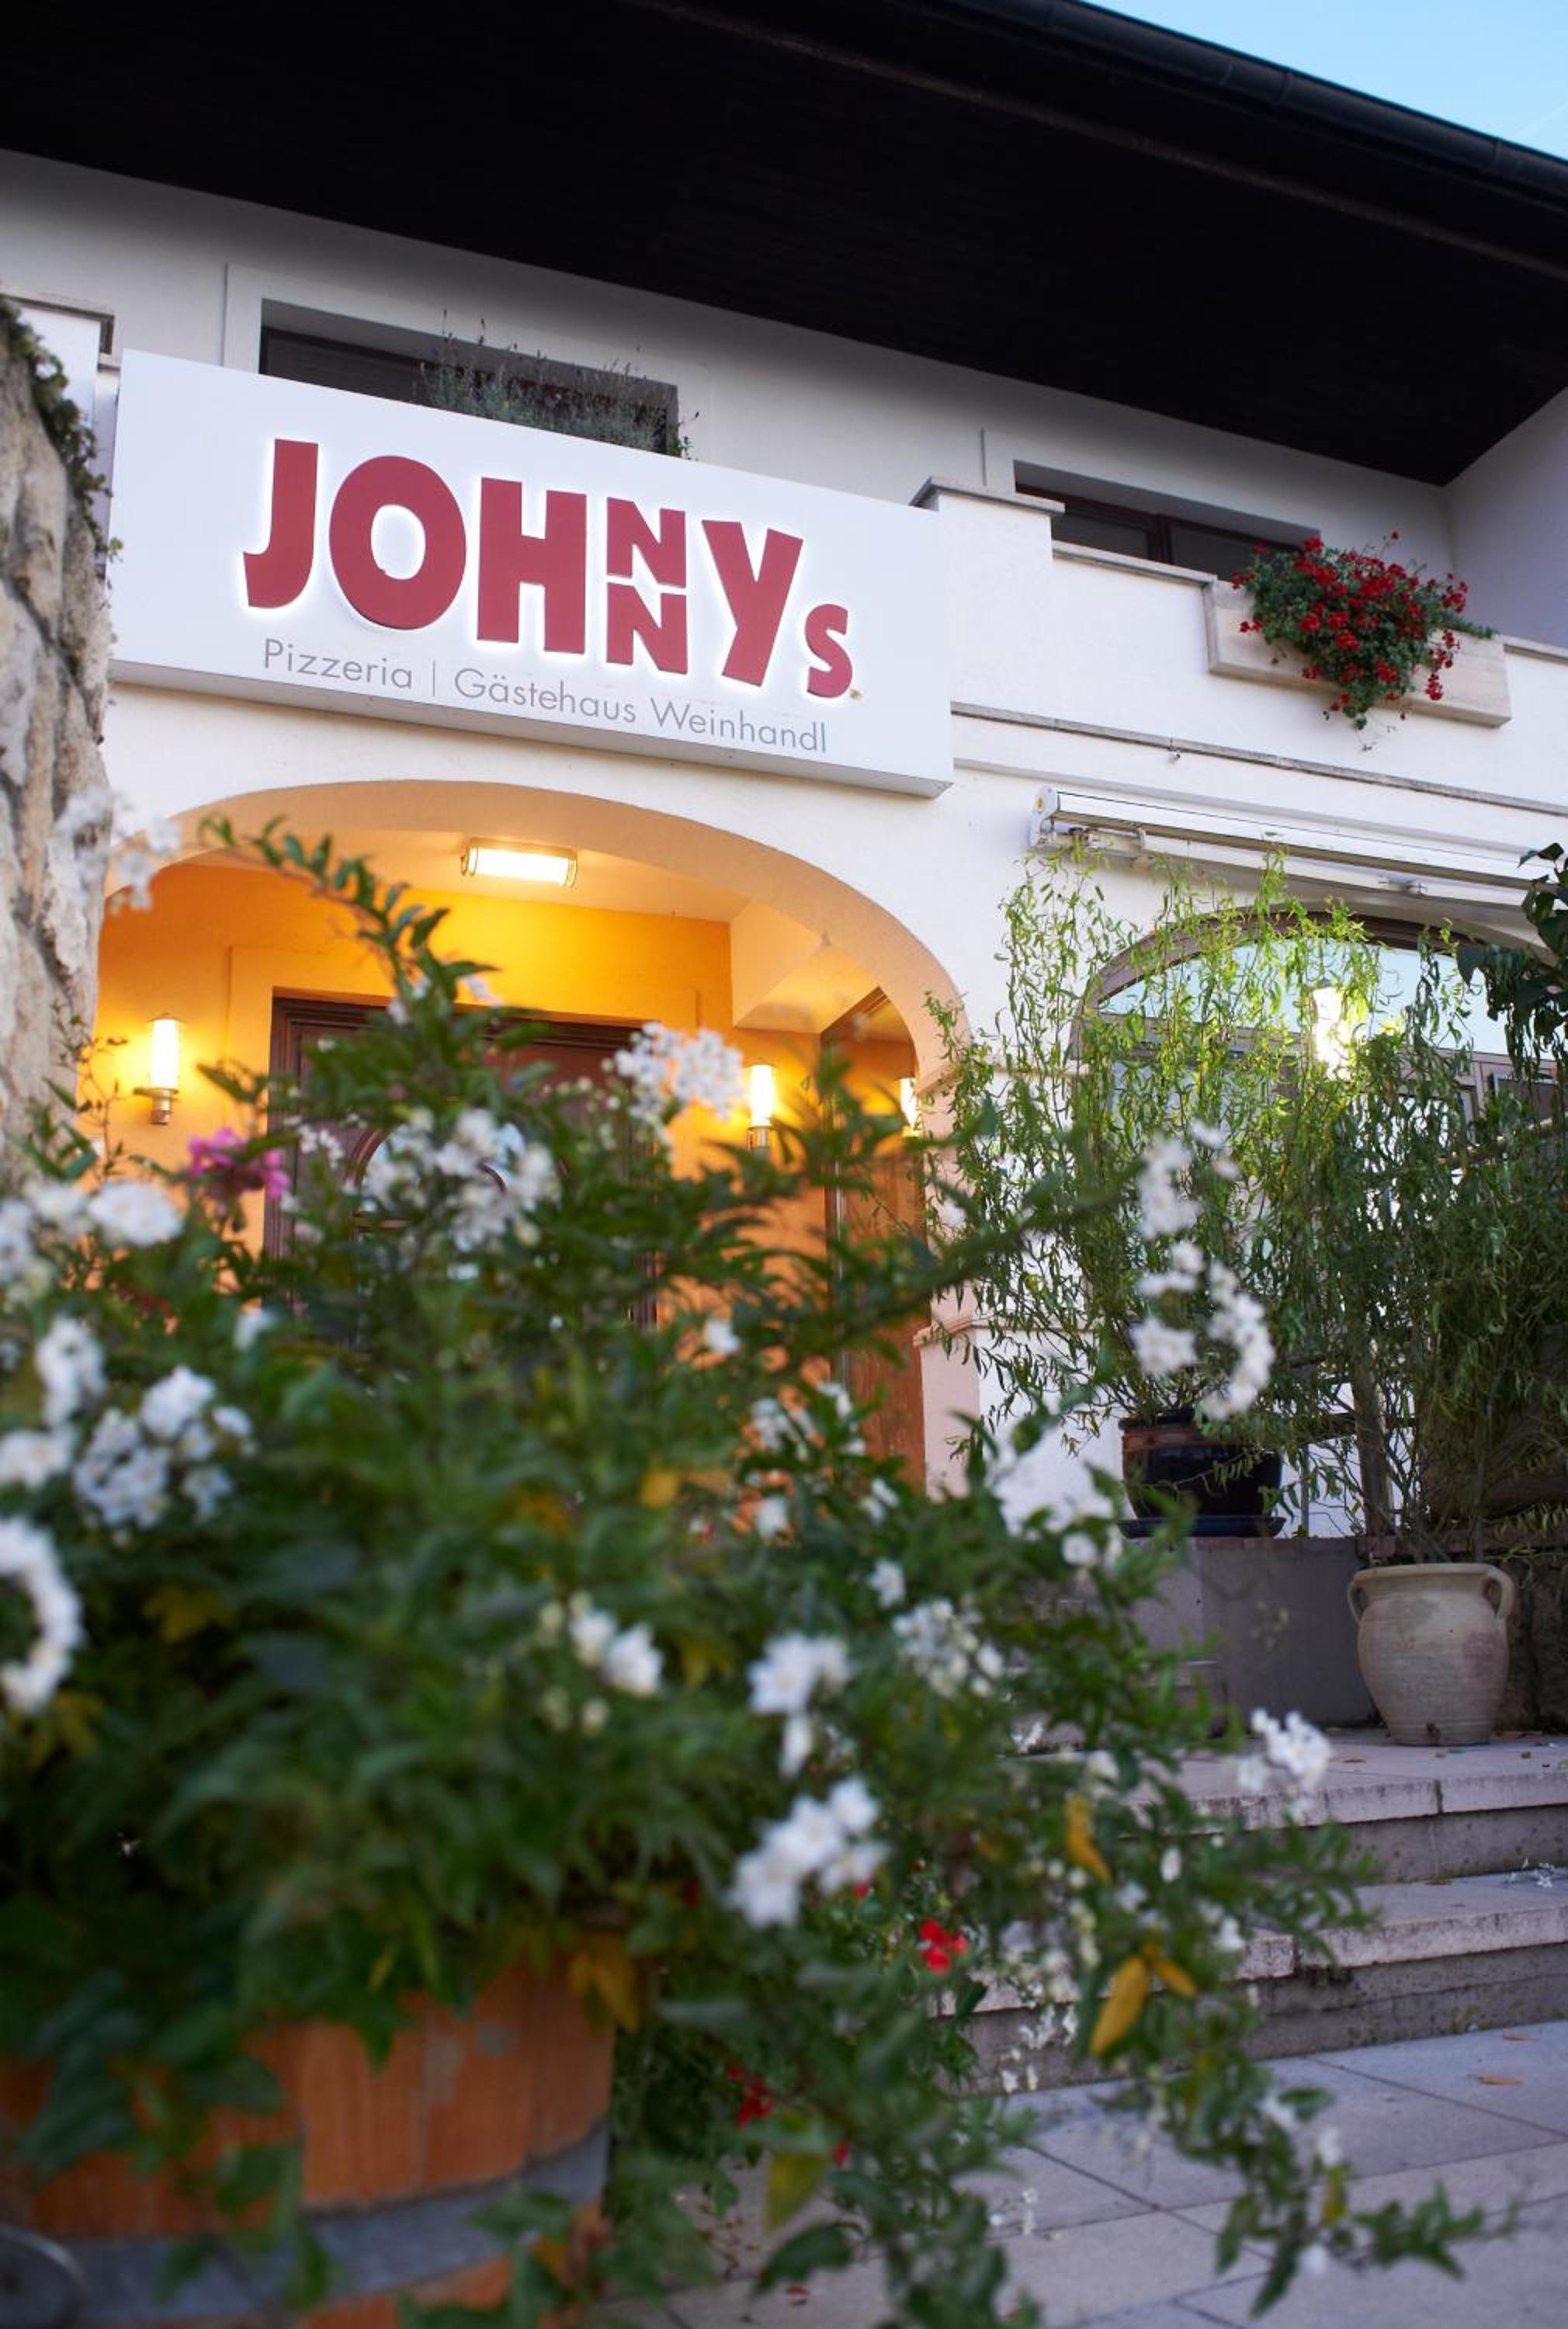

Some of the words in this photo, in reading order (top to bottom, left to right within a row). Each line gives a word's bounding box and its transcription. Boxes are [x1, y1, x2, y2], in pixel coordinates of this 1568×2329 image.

[264, 637, 412, 689] Pizzeria
[454, 668, 637, 723] Gästehaus
[650, 697, 827, 753] Weinhandl
